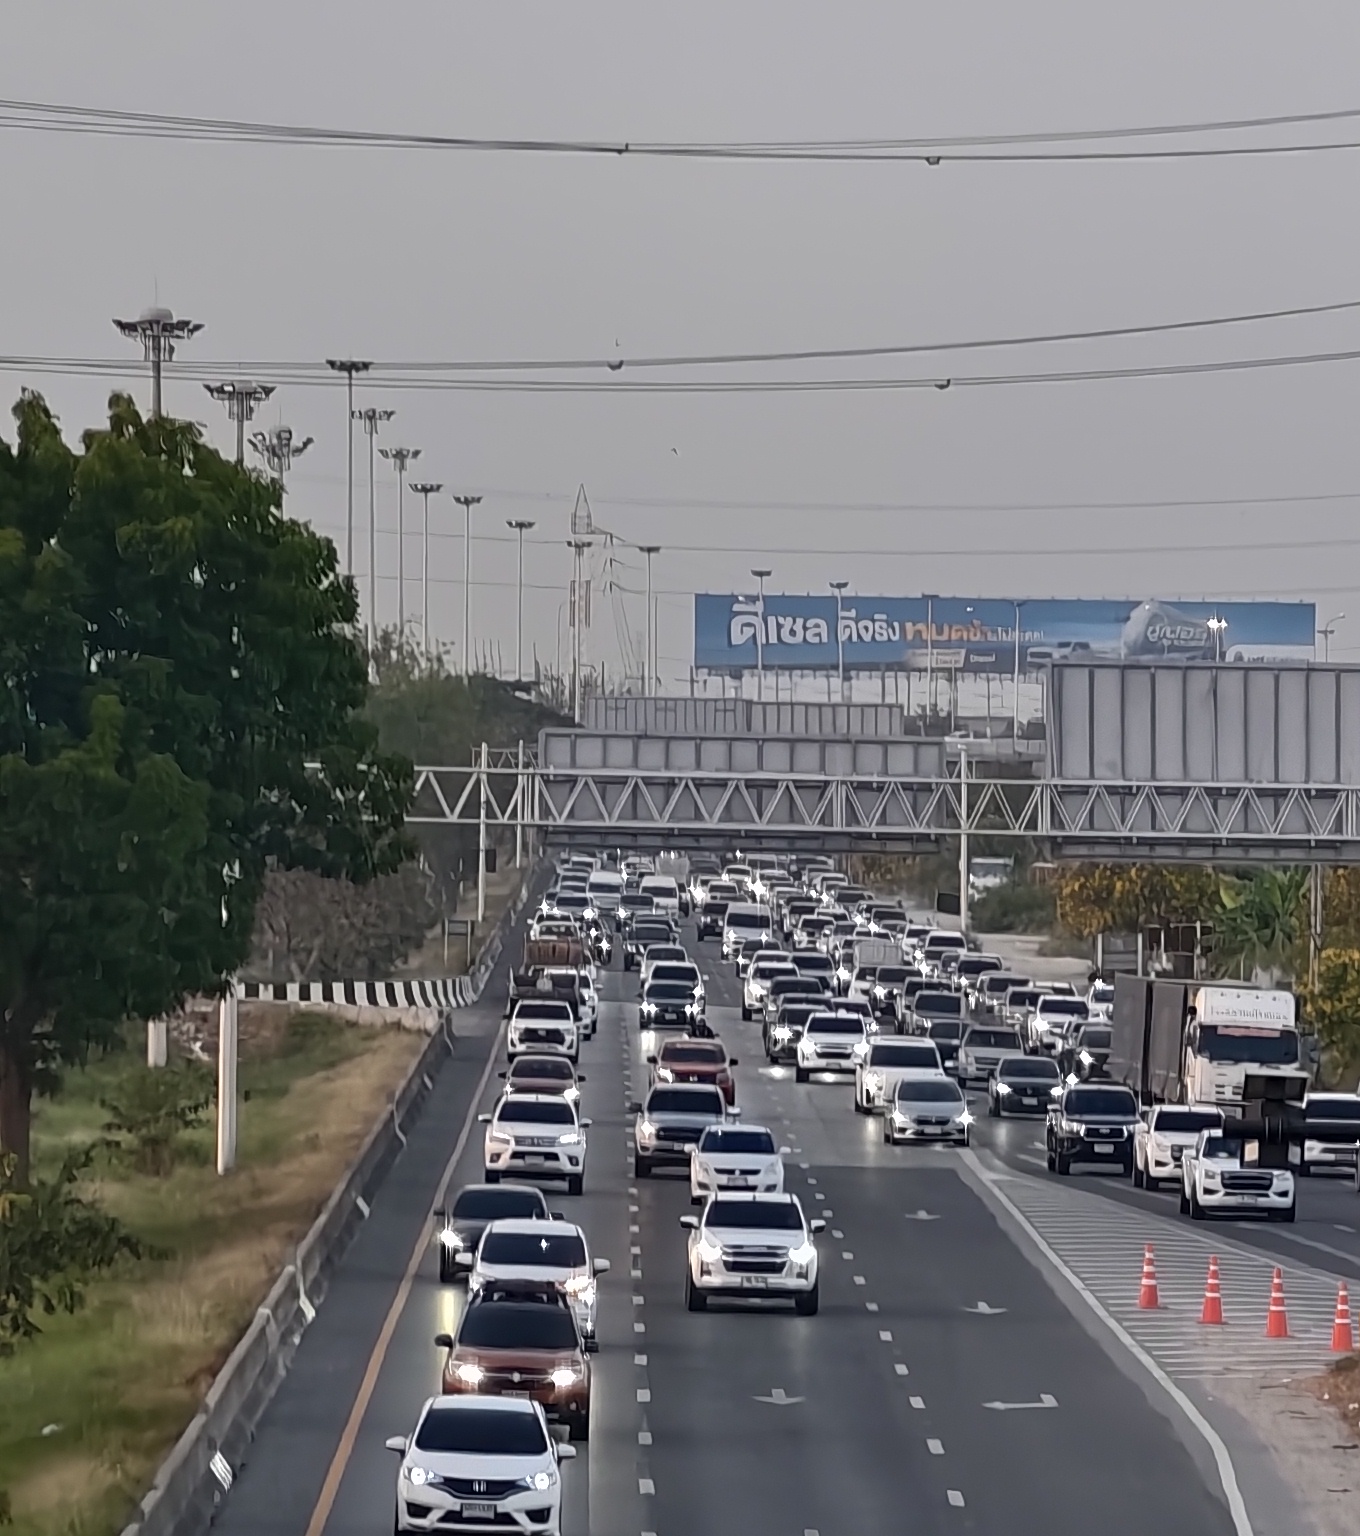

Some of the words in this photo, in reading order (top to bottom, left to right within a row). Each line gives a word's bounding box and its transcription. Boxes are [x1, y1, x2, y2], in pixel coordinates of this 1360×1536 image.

[730, 600, 828, 645] ดีเซล
[838, 608, 900, 643] ดีจริง
